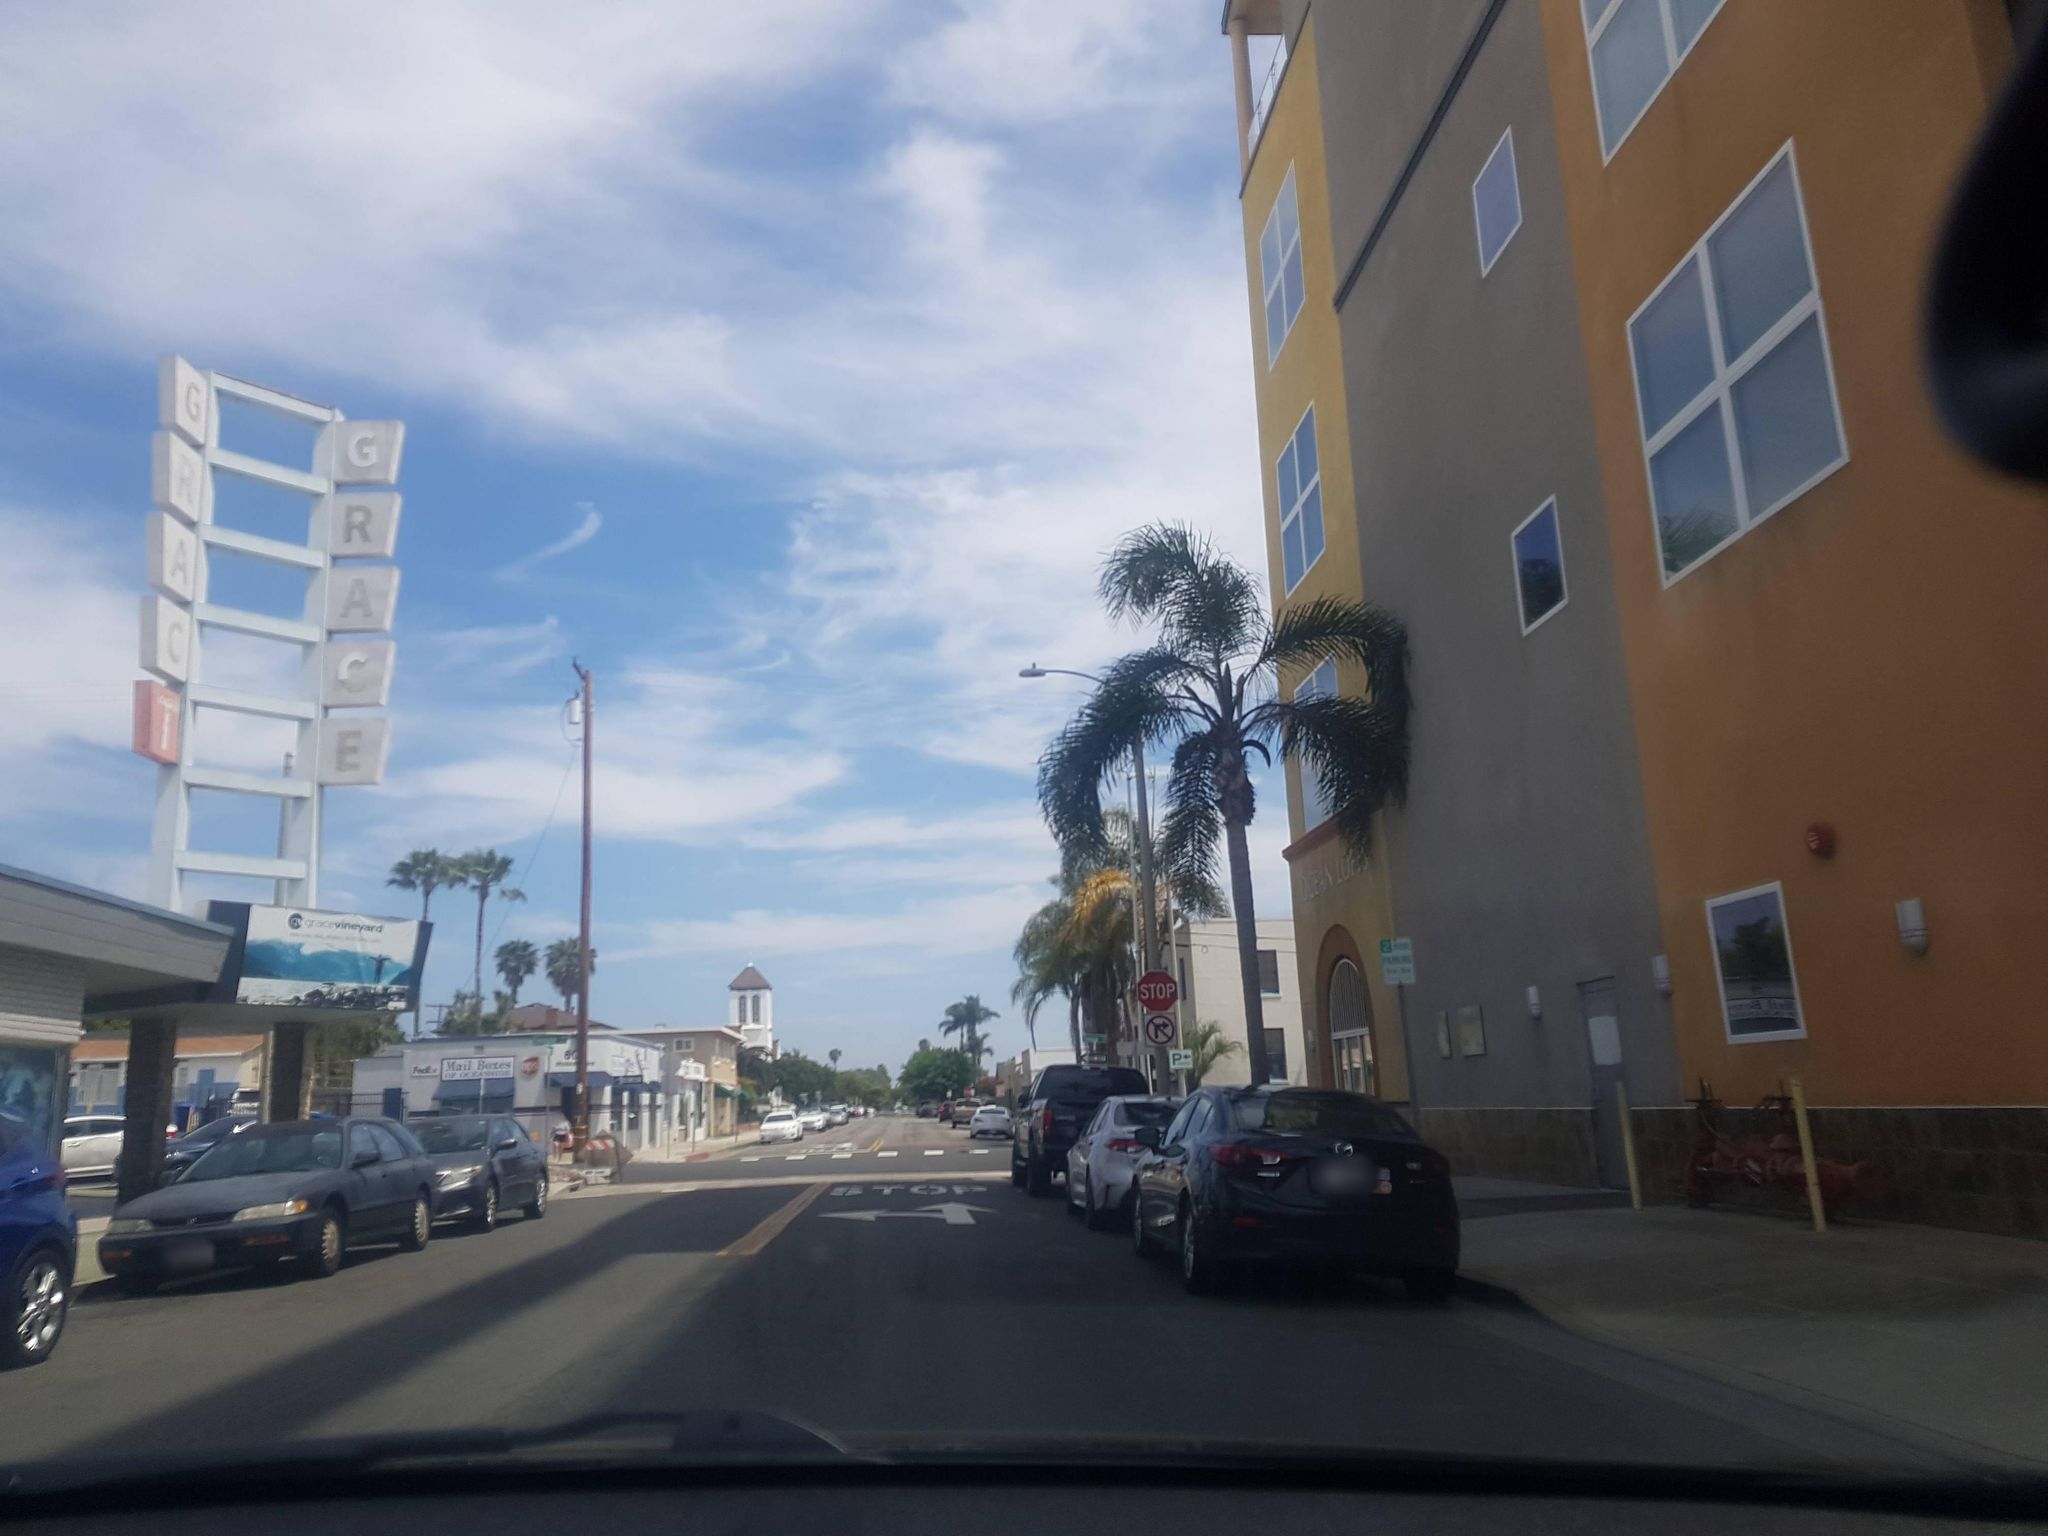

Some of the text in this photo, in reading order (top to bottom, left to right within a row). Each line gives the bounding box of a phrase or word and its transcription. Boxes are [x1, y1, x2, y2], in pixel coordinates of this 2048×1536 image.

[336, 431, 379, 773] GRACE
[1140, 983, 1176, 999] STOP
[445, 1059, 511, 1072] Mail Boxes
[1172, 1053, 1182, 1066] P
[829, 1184, 988, 1197] STOP
